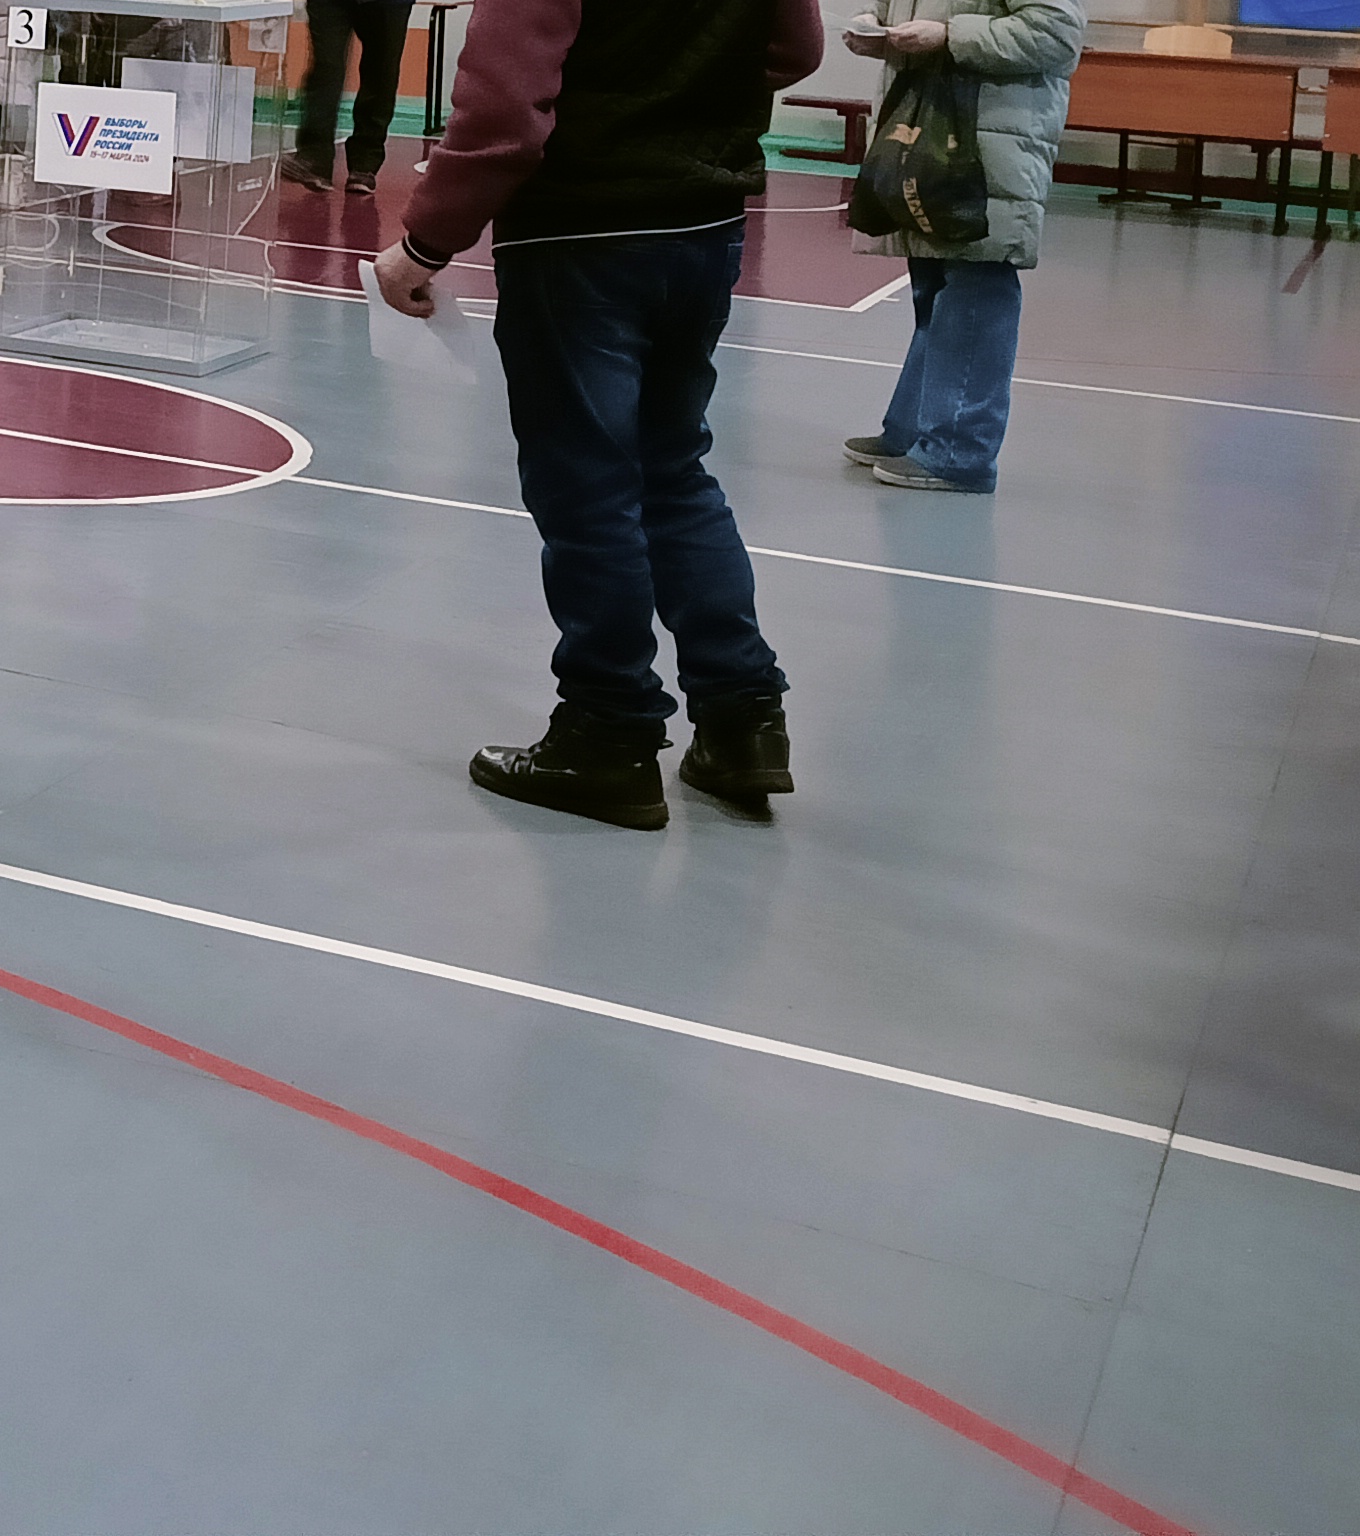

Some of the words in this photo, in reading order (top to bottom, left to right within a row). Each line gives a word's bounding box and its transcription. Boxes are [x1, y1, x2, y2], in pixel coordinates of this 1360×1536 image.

[15, 9, 33, 44] 3
[104, 117, 148, 129] ВЫБОРЫ
[99, 128, 160, 142] ПРЕЗИДЕНТА
[93, 140, 133, 151] РОССИИ
[109, 152, 132, 162] МАРТА
